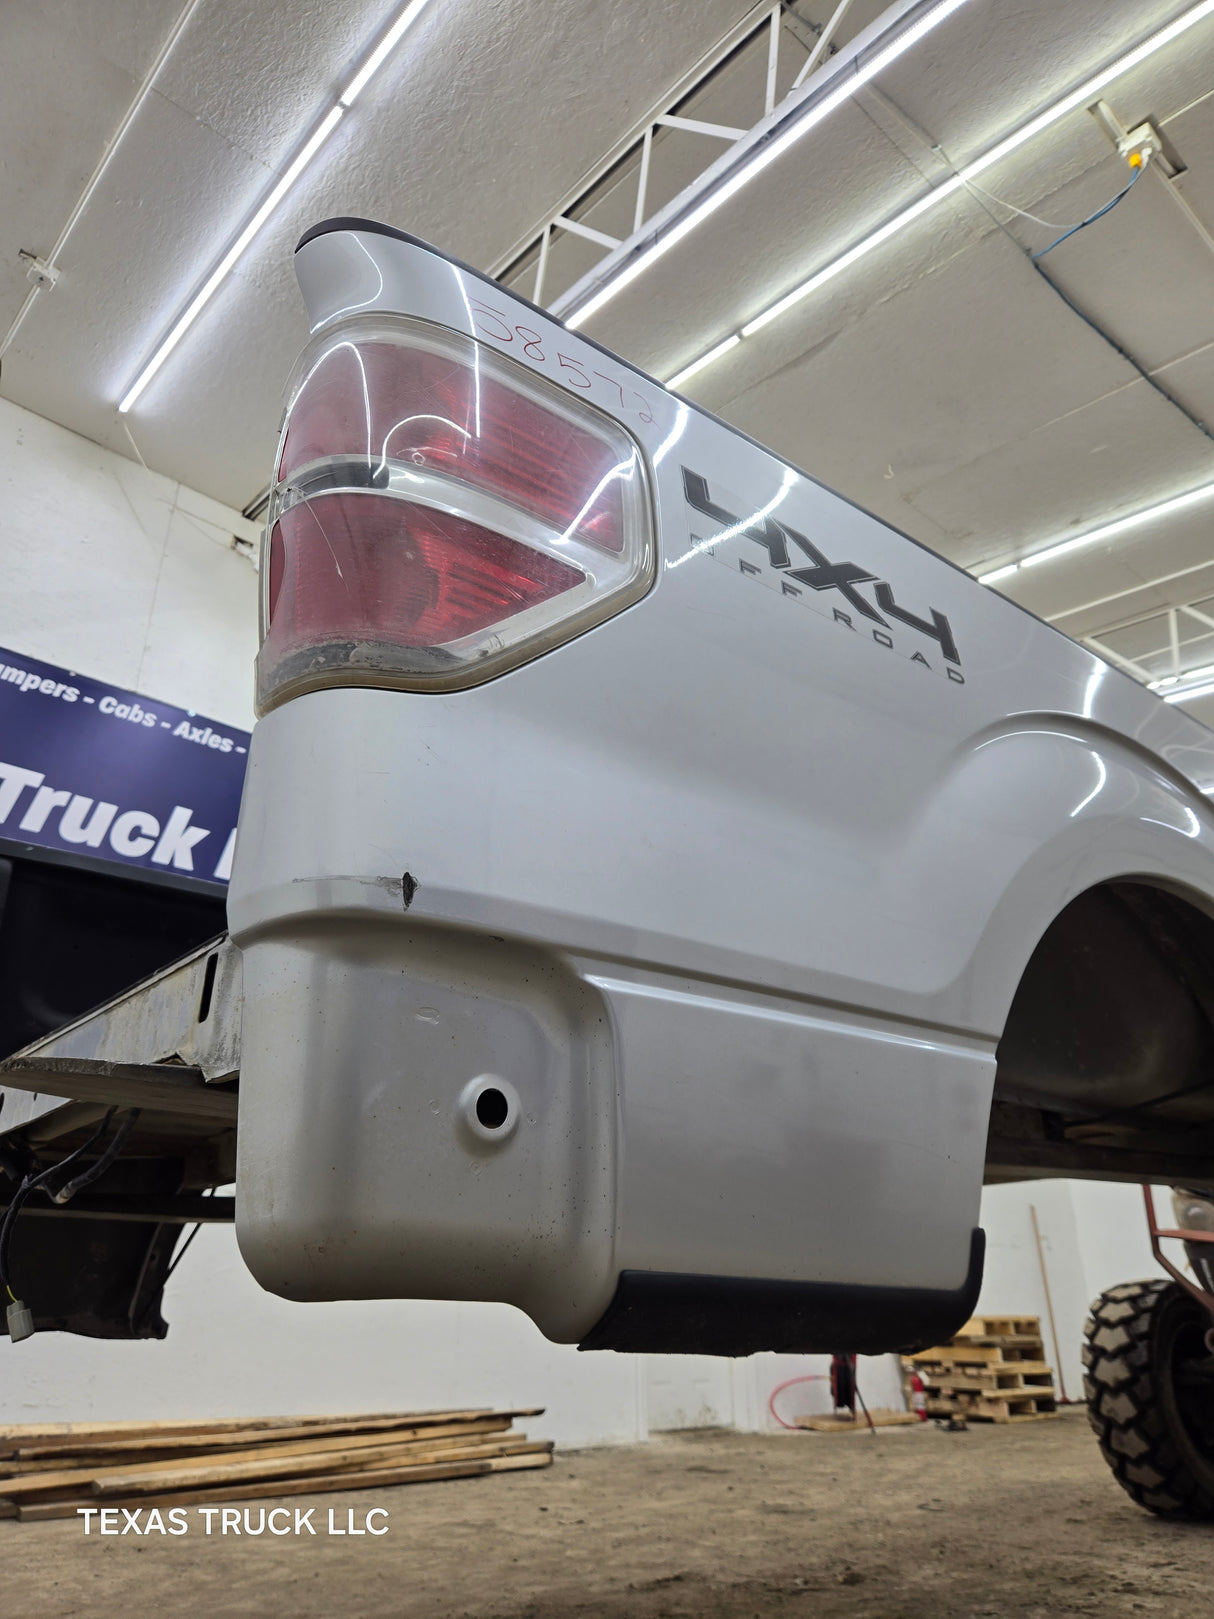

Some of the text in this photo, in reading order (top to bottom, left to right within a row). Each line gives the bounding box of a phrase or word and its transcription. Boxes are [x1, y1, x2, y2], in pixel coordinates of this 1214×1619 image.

[466, 296, 660, 429] 58572
[681, 465, 961, 665] 4X4
[99, 695, 158, 728] Cabs
[173, 721, 233, 753] Axles
[0, 762, 211, 871] Truck
